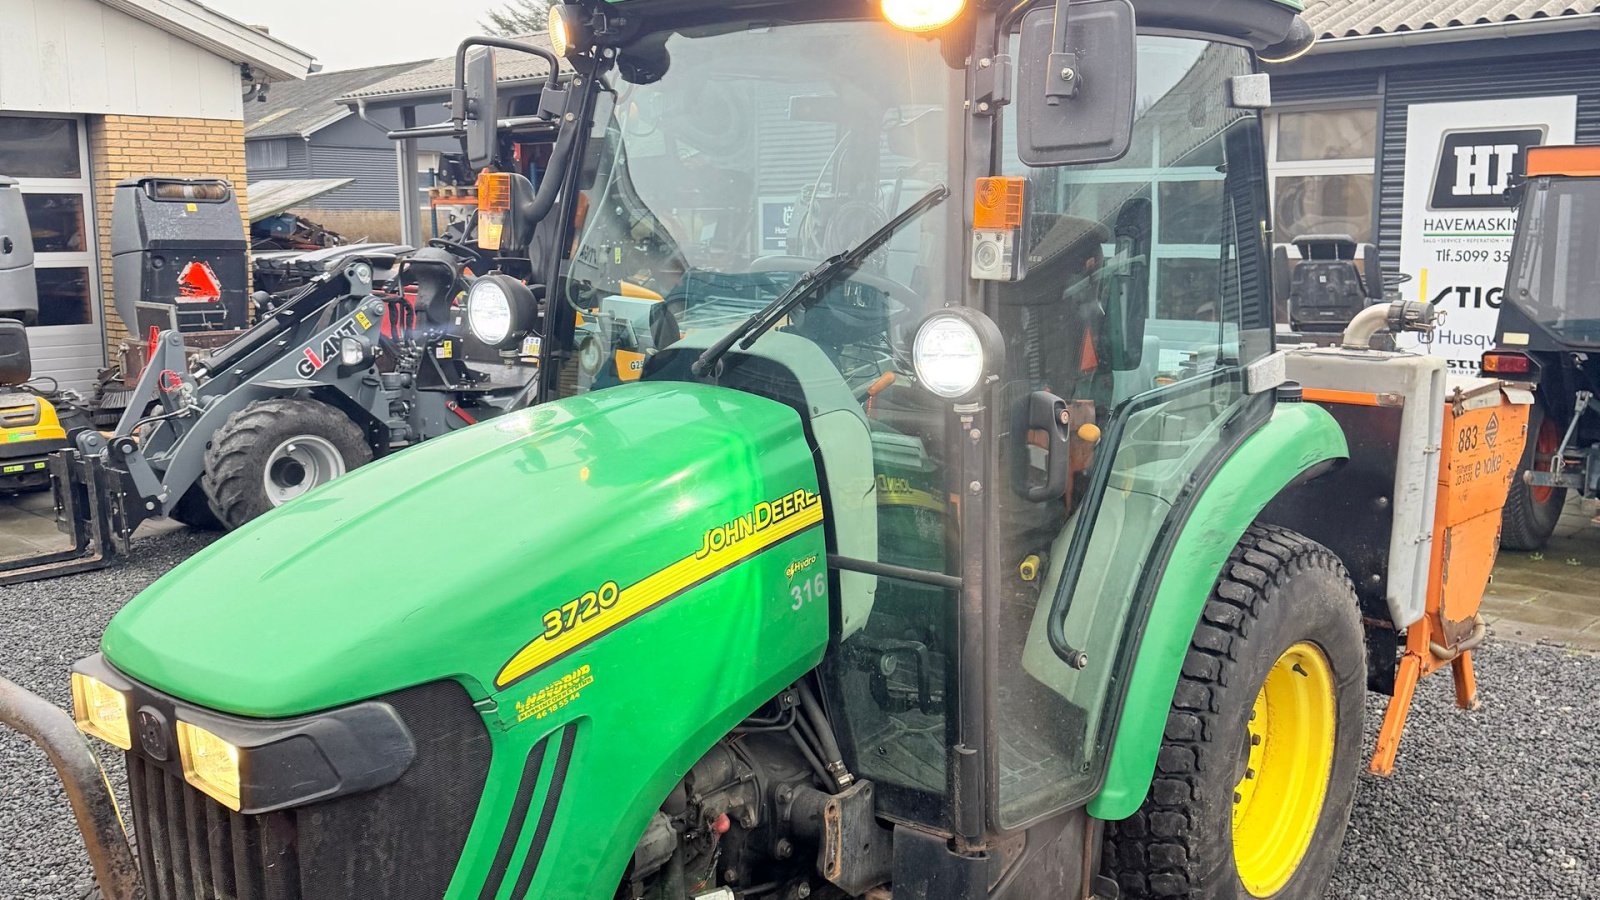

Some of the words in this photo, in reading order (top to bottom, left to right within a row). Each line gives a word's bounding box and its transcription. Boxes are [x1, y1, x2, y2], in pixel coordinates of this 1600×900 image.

[1423, 218, 1518, 231] HAVEMASKIN
[1430, 286, 1503, 309] STIG
[1439, 329, 1496, 350] Husqv
[1458, 425, 1478, 453] 883
[695, 511, 756, 561] JOHN
[753, 488, 818, 532] DEERE
[790, 572, 825, 611] 316
[542, 580, 620, 641] 3720
[536, 710, 547, 719] 46
